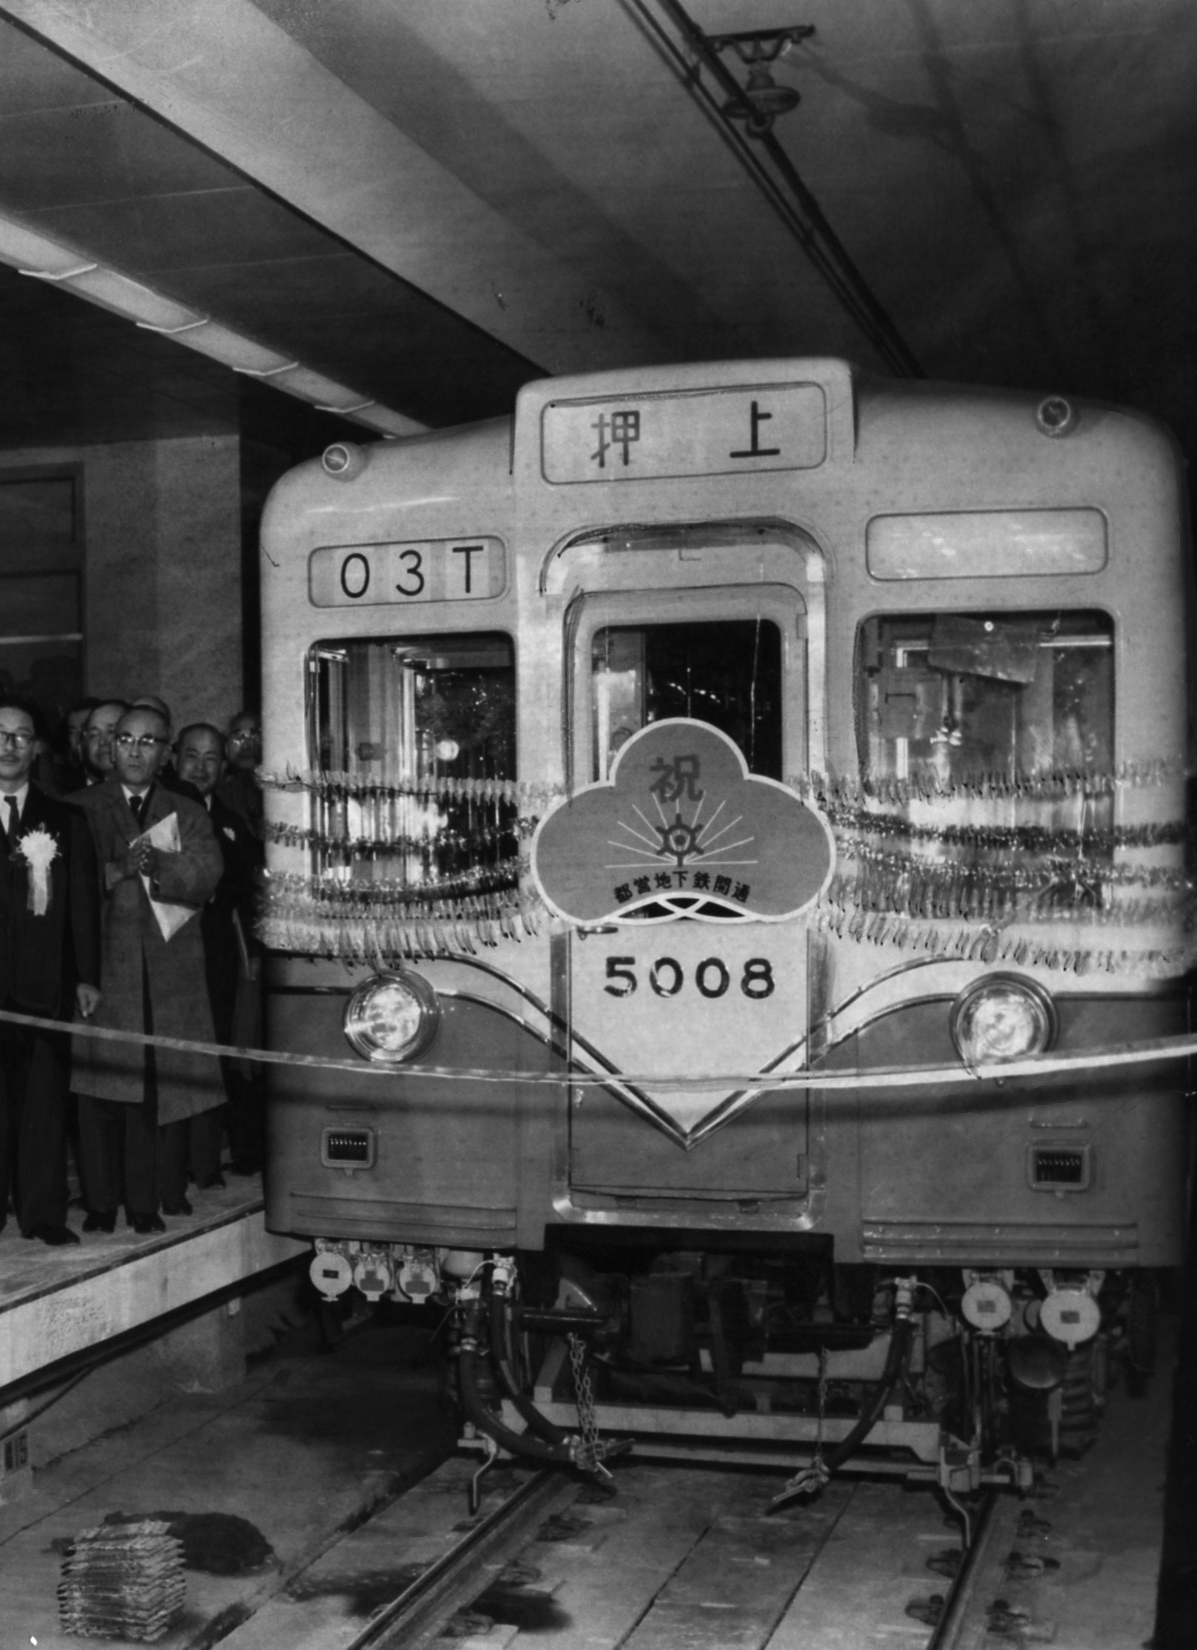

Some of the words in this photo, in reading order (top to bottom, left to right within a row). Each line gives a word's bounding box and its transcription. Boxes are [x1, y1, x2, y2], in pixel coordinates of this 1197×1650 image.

[590, 399, 781, 468] 押上
[340, 545, 484, 599] 03T
[648, 754, 704, 804] 祝
[603, 955, 776, 999] 5008
